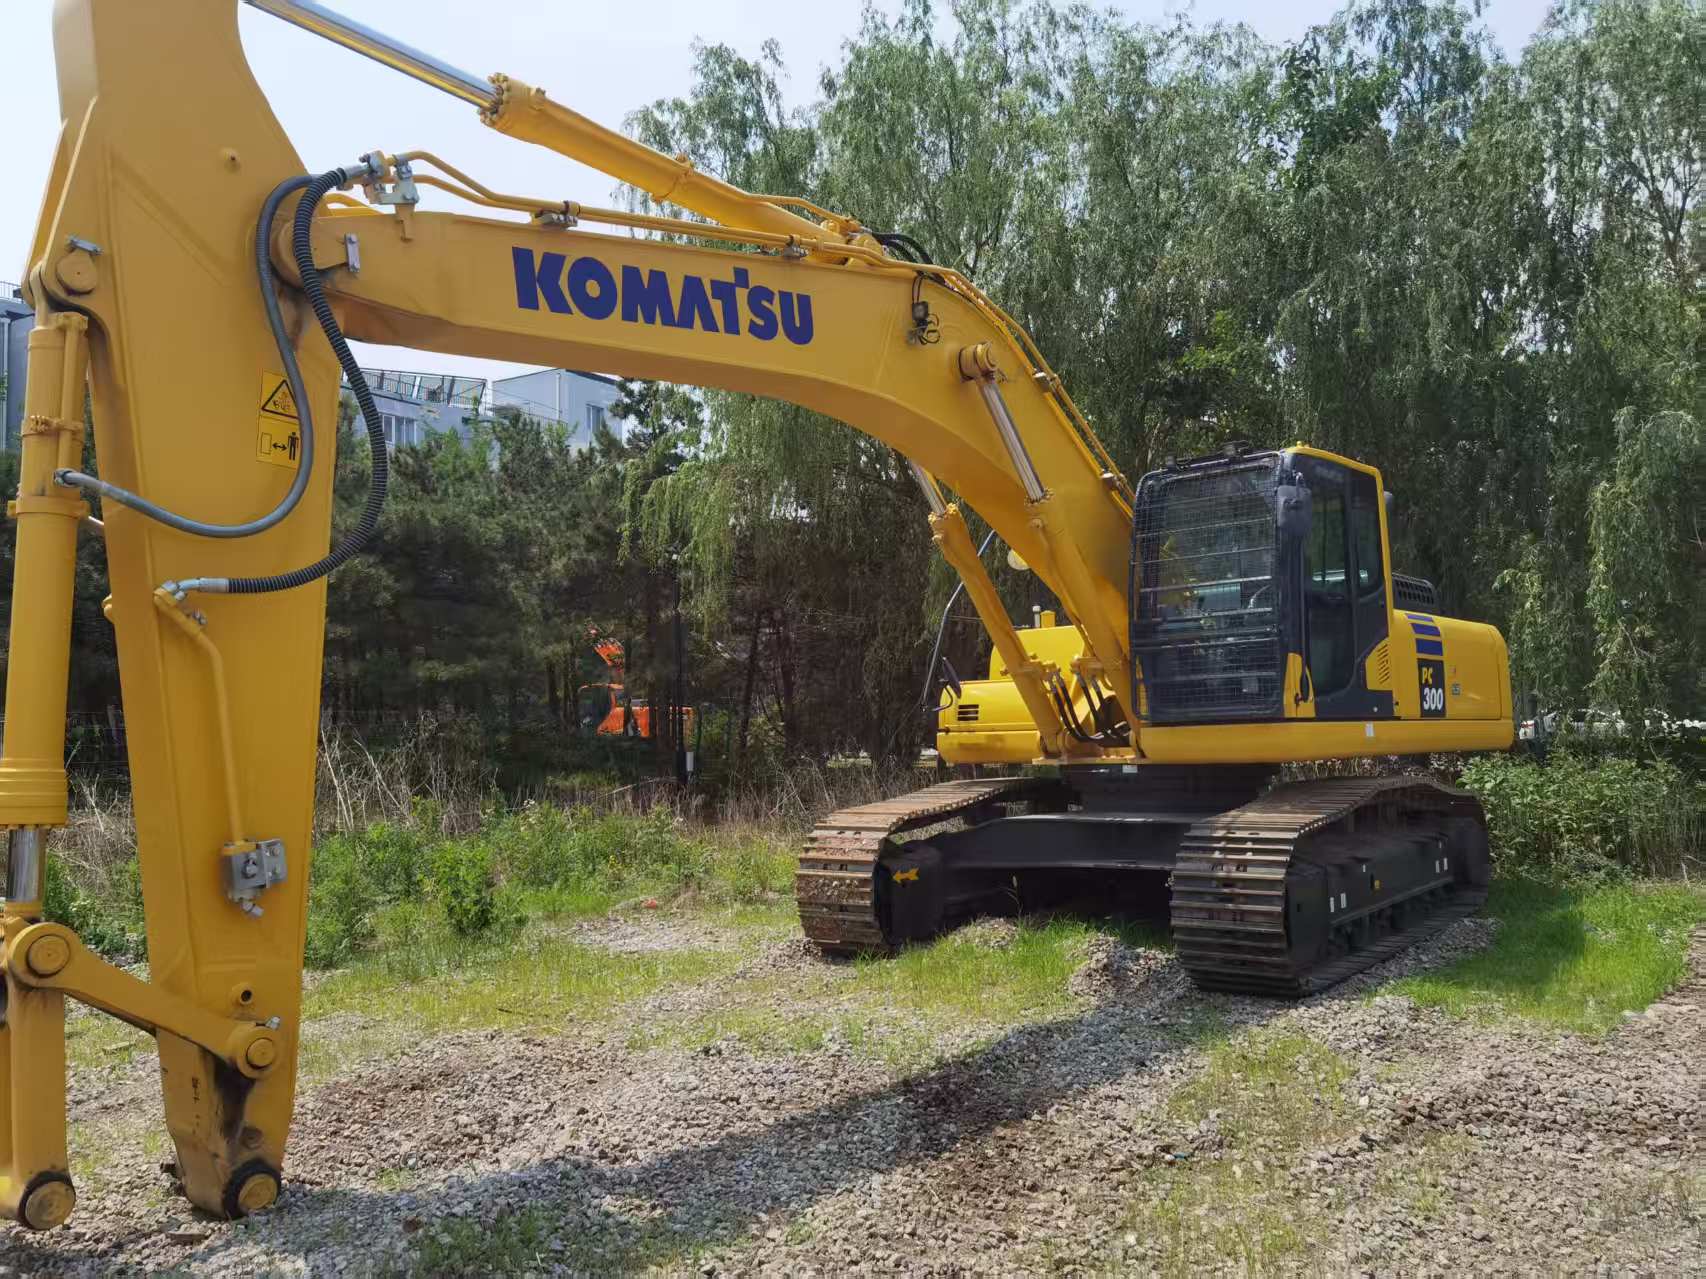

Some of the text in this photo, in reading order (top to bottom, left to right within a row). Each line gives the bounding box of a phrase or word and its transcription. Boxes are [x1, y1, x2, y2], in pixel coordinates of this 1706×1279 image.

[512, 246, 814, 345] KOMATSU
[1421, 667, 1433, 685] PC
[1423, 687, 1444, 711] 300
